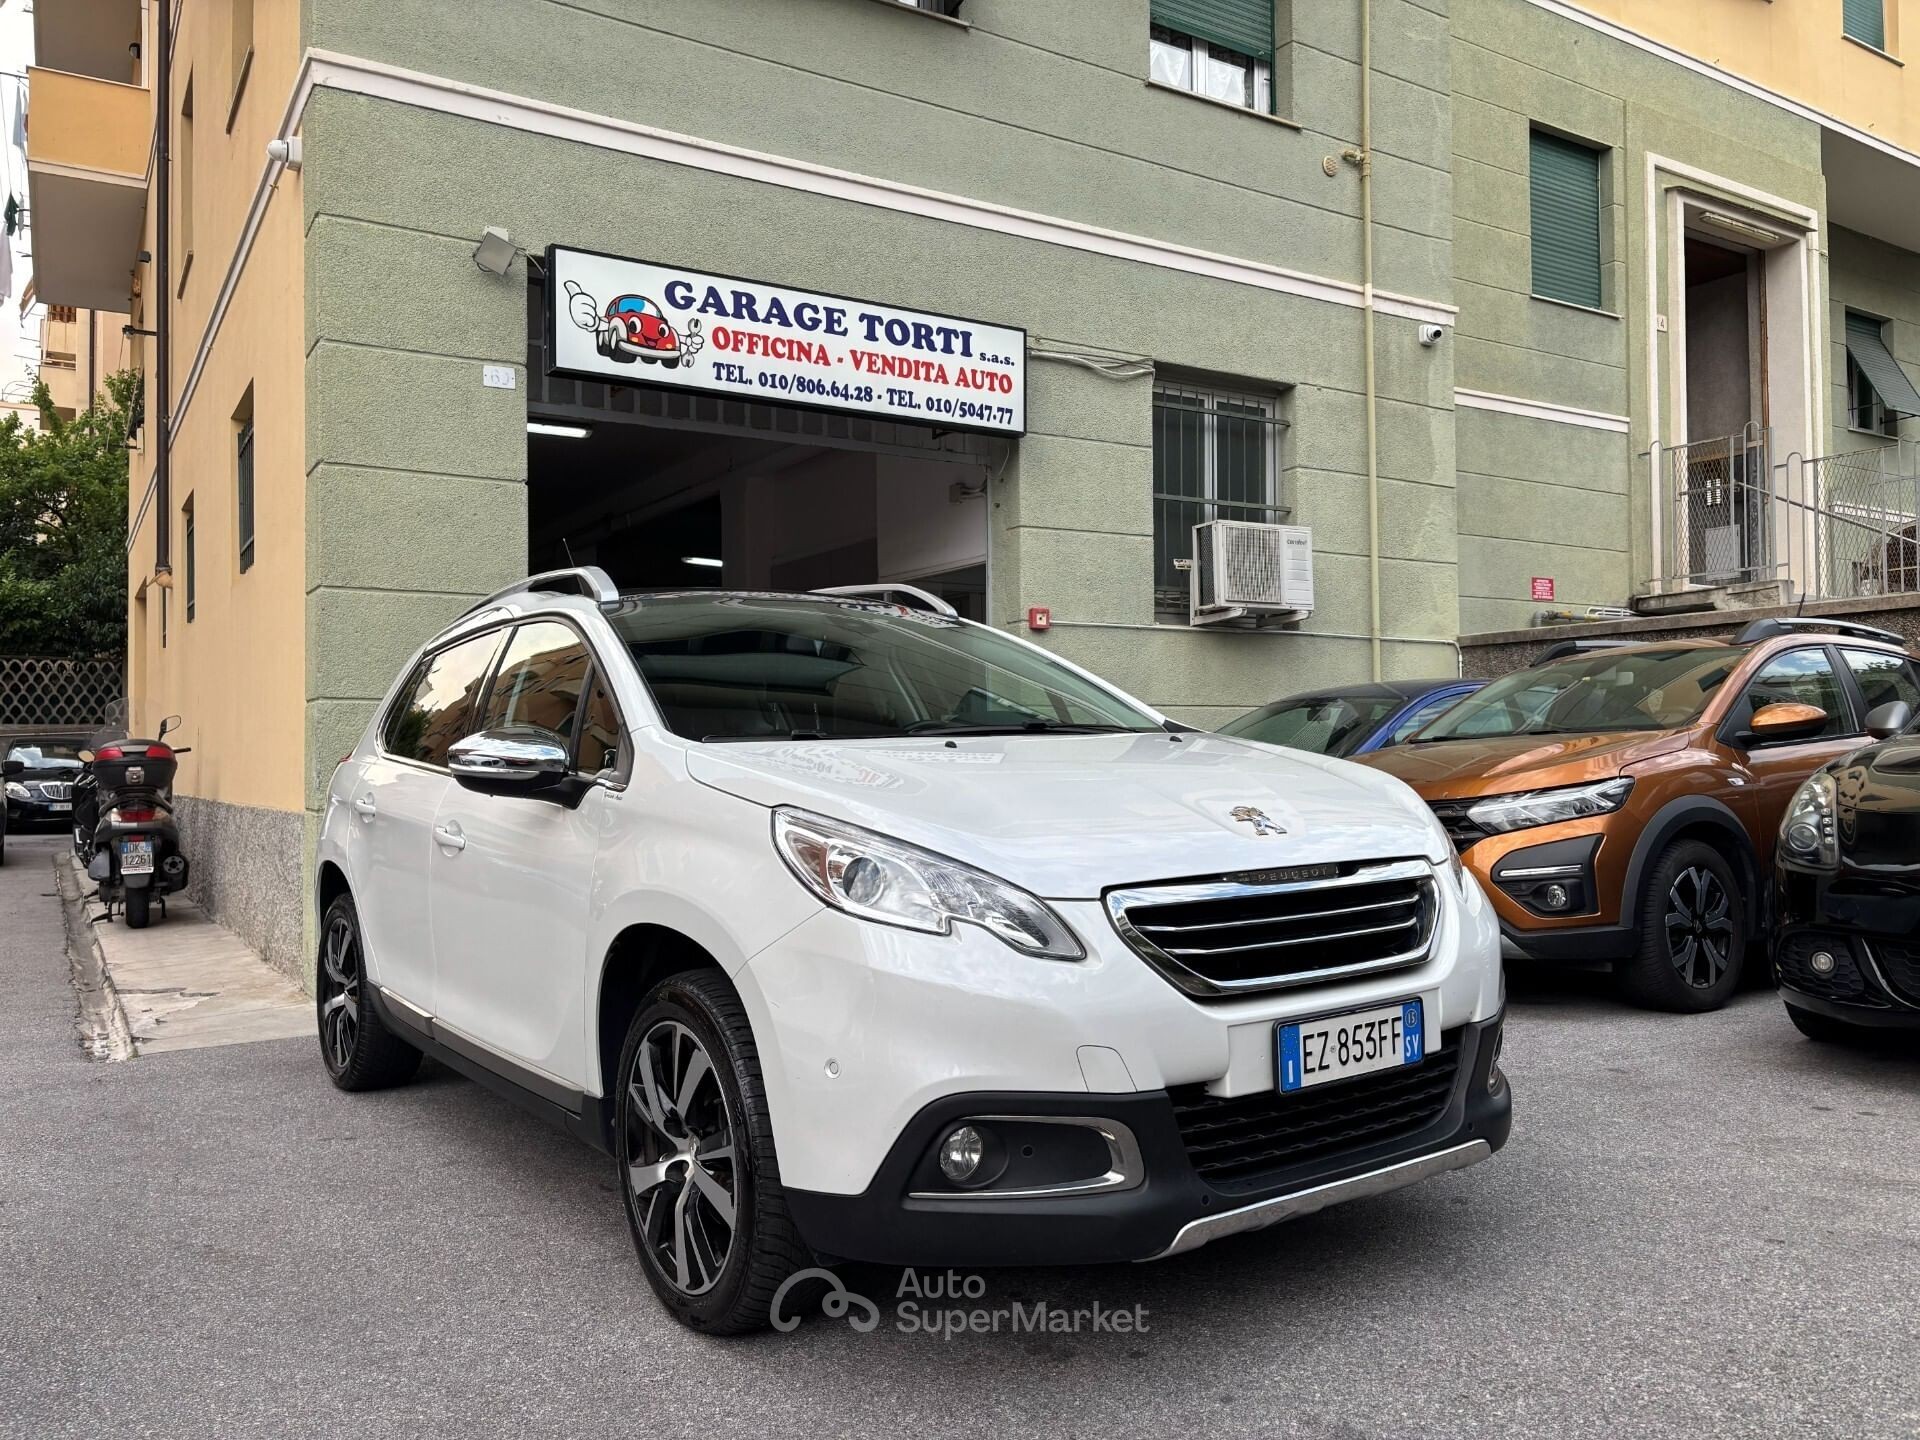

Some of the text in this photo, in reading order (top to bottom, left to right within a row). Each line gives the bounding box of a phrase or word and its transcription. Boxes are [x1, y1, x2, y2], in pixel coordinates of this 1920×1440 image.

[664, 280, 1015, 367] GARAGE TORTI s.a.s.
[711, 326, 832, 367] OFFICINA
[850, 349, 950, 385] VENDITA
[954, 366, 1013, 394] AUTO
[712, 361, 753, 386] TEL.
[758, 371, 874, 403] 010/806.64.28
[886, 387, 922, 410] TEL.
[925, 396, 1014, 425] 010/5047.77
[1258, 866, 1328, 882] PEUGEOT
[1302, 1031, 1330, 1074] EZ
[1337, 1016, 1402, 1066] 853FF
[1405, 1033, 1419, 1058] SV
